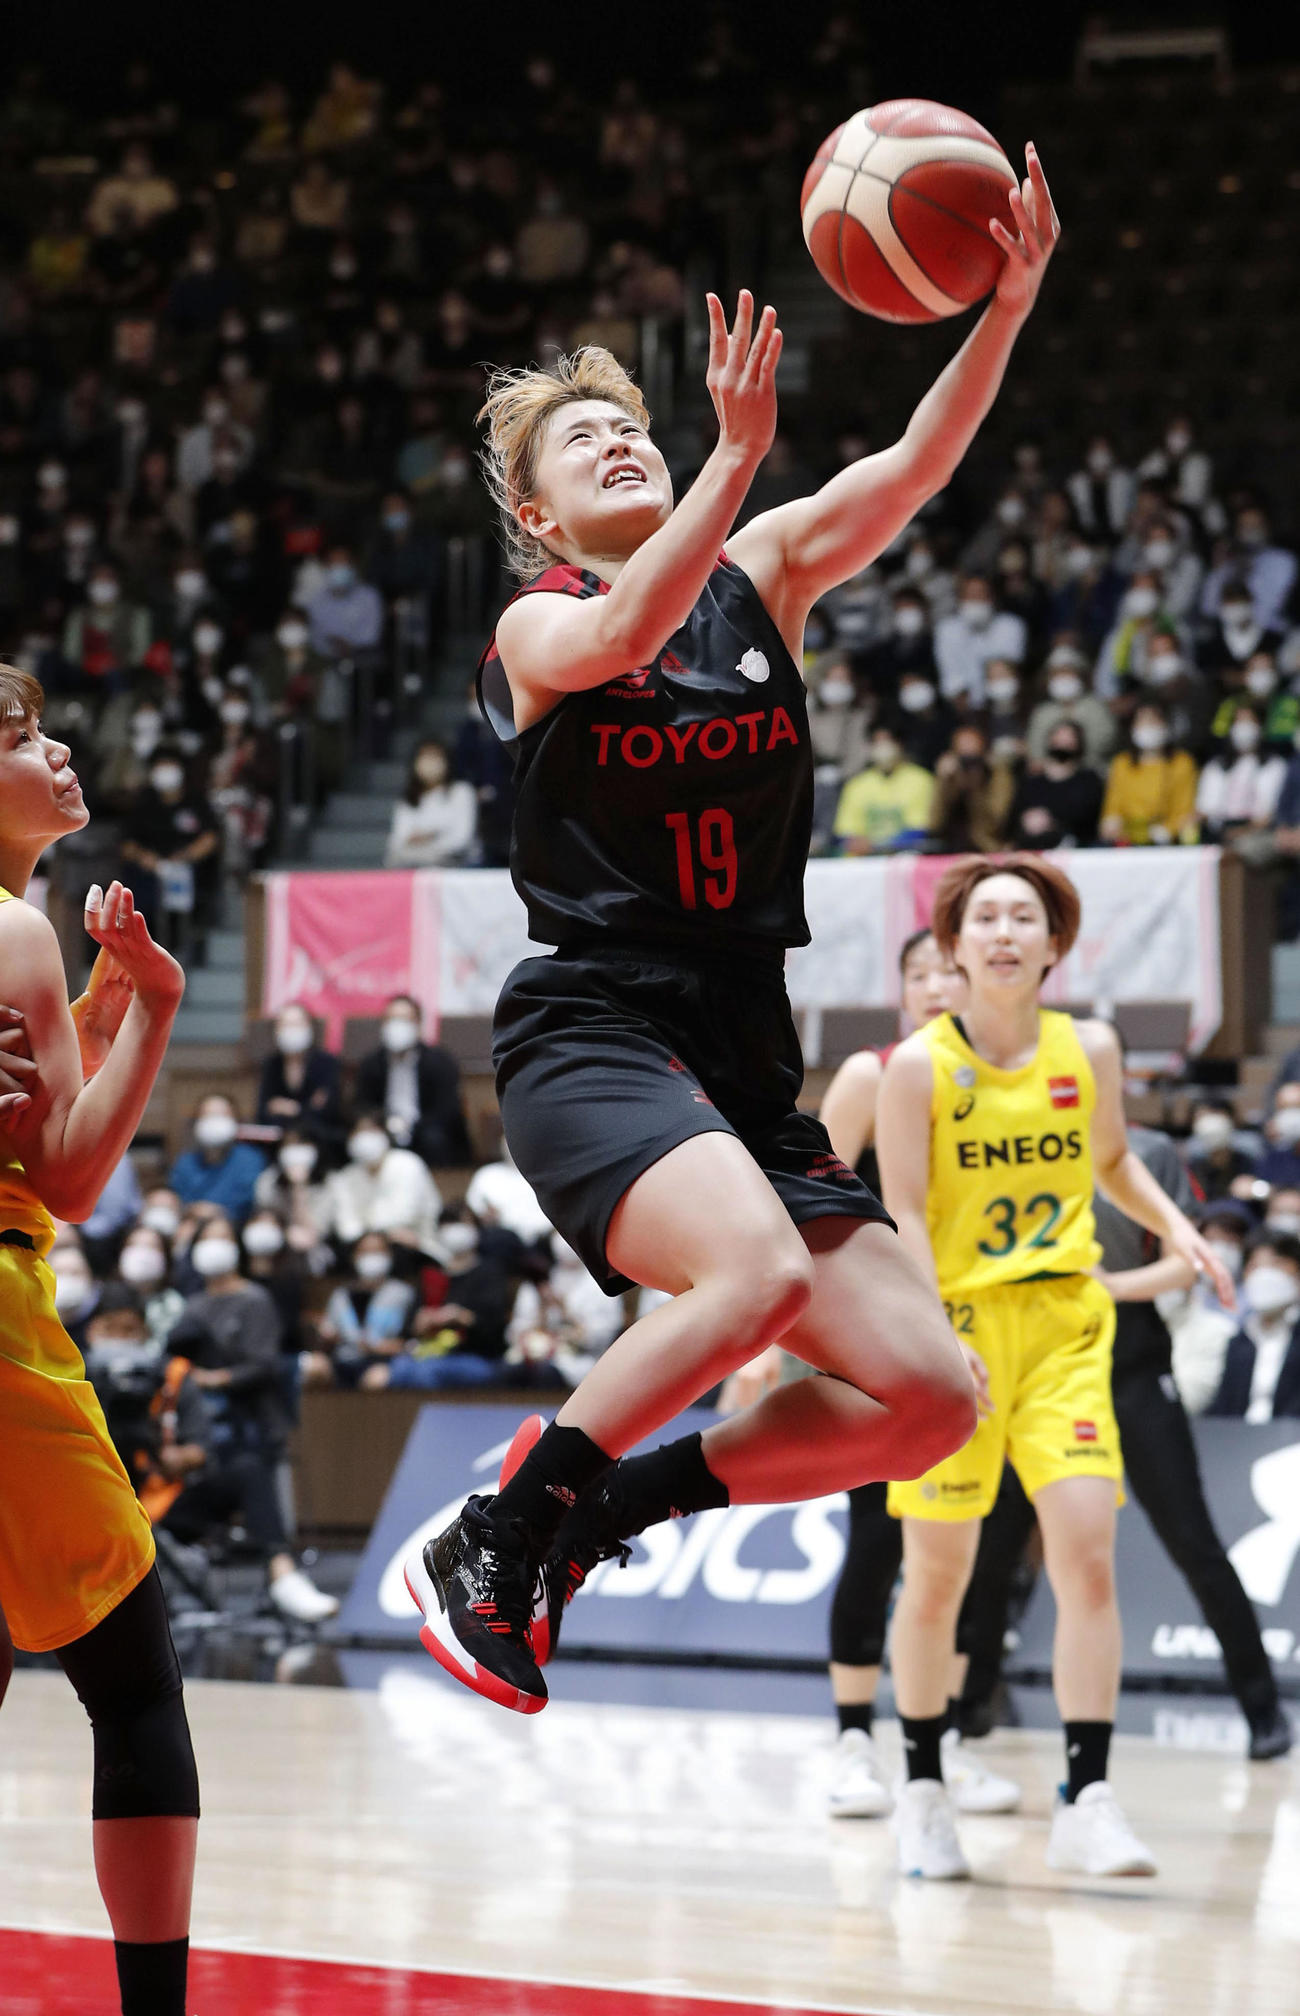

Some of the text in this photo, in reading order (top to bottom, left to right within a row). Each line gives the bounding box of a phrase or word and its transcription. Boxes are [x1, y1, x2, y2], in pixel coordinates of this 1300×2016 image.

[590, 706, 799, 768] TOYOTA
[665, 808, 738, 910] 19
[957, 1131, 1082, 1169] ENEOS
[978, 1193, 1063, 1258] 32
